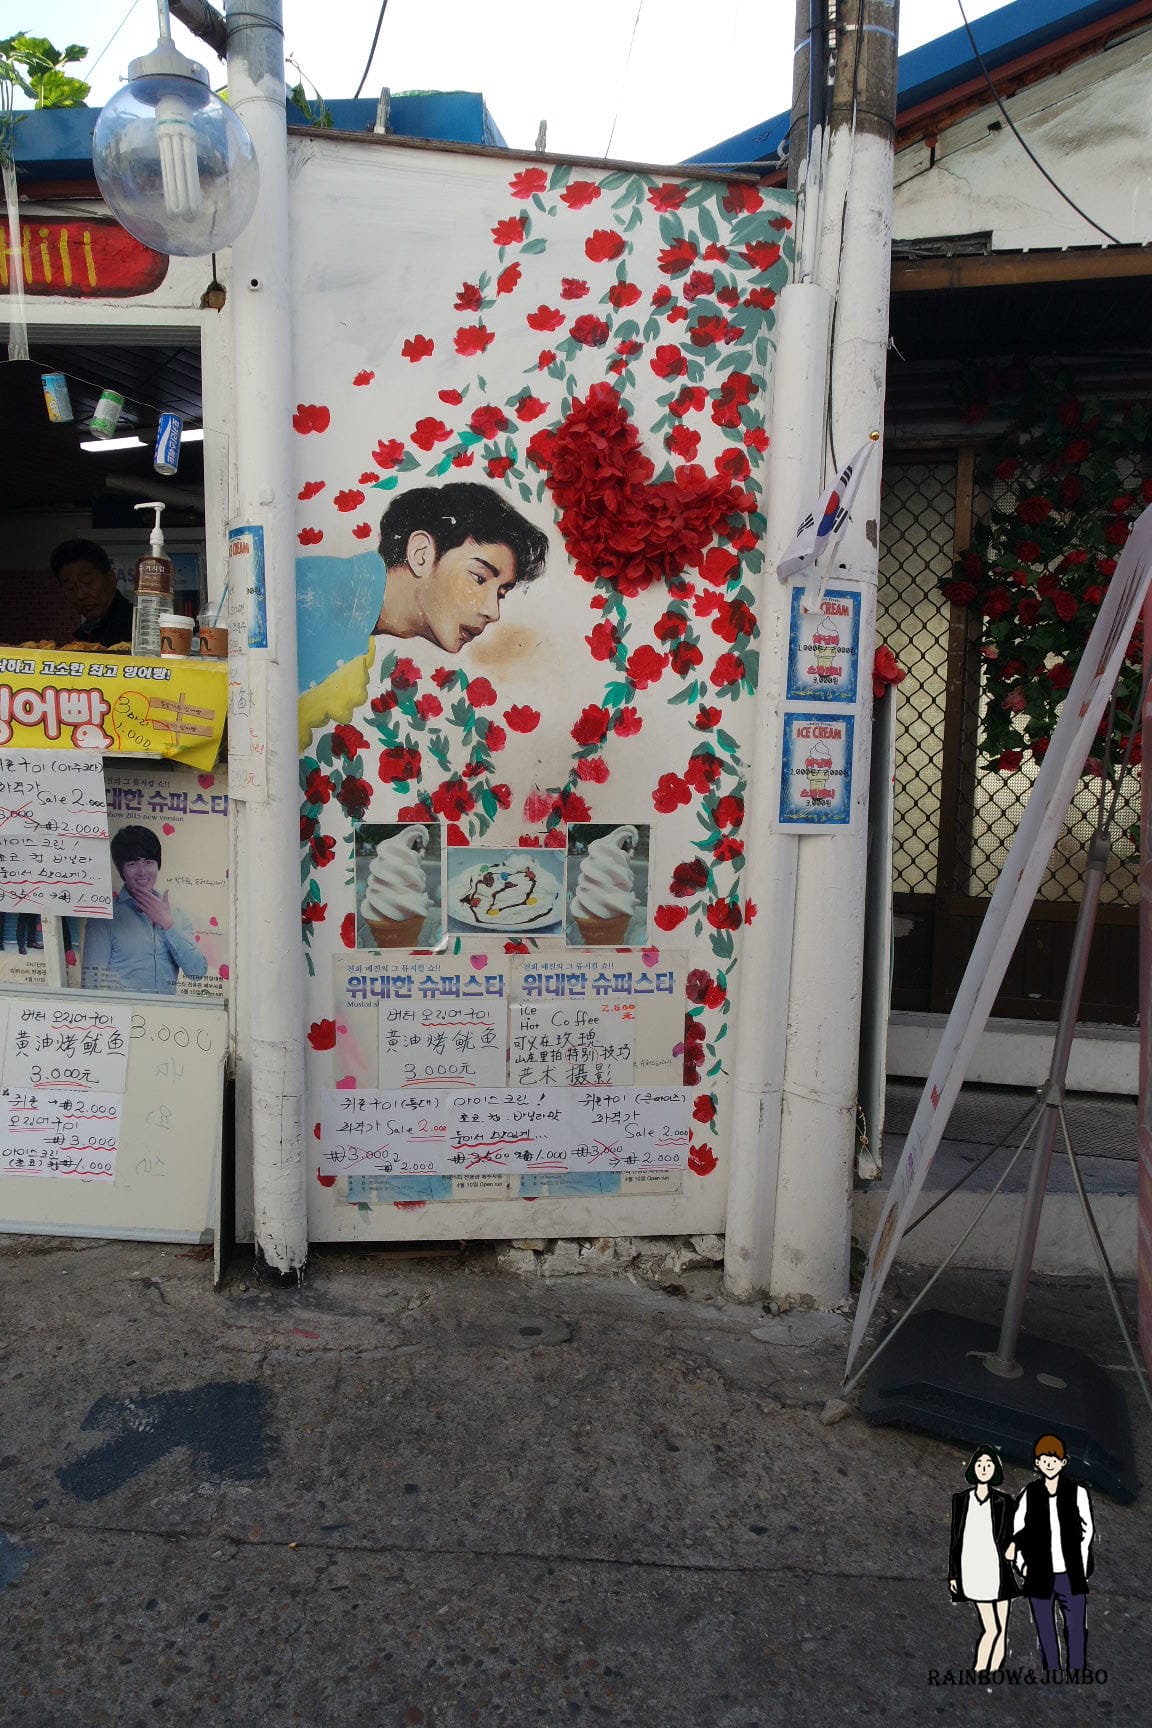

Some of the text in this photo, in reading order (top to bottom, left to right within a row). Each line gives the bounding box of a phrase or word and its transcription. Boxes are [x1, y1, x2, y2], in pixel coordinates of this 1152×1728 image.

[40, 661, 85, 676] 고소한
[88, 664, 118, 677] 최고
[123, 666, 171, 680] 잉어빵!
[796, 726, 841, 739] ICE CREAM
[37, 790, 67, 806] Sale
[346, 975, 506, 999] 위대한 슈퍼스타
[522, 972, 676, 996] 위대한 슈퍼스타
[21, 1009, 45, 1021] 버터
[387, 1009, 415, 1021] 버터
[520, 1021, 540, 1031] Hot
[386, 1119, 414, 1135] Sale
[624, 1122, 655, 1139] Sale
